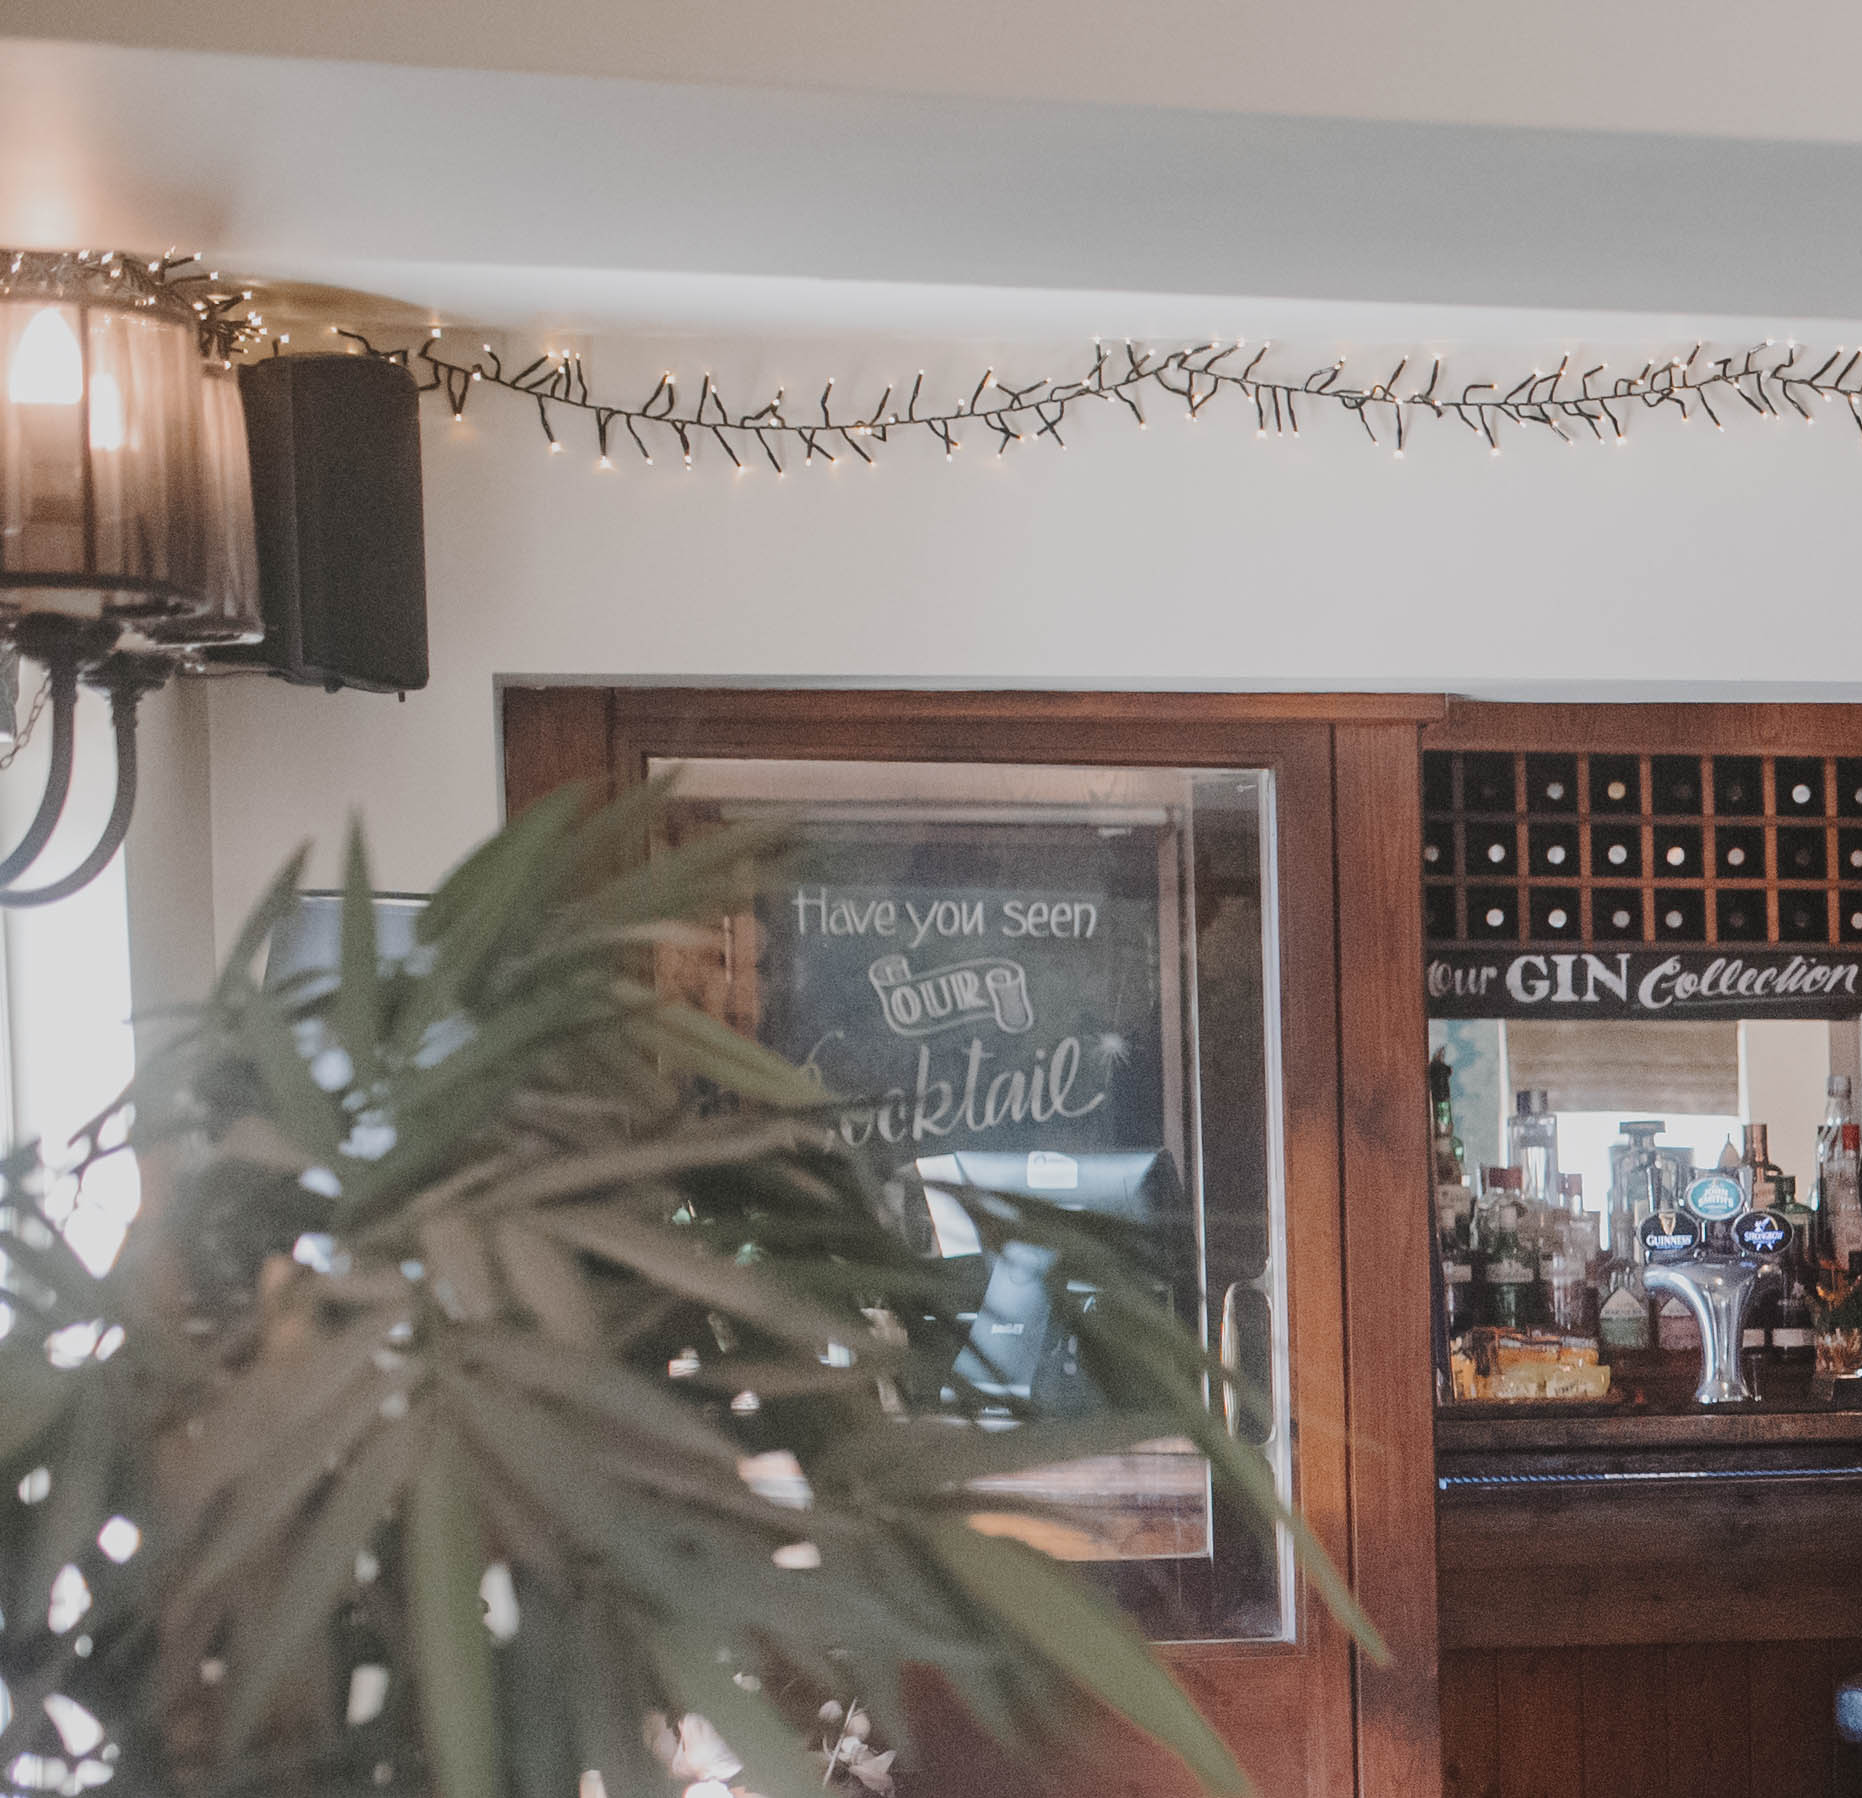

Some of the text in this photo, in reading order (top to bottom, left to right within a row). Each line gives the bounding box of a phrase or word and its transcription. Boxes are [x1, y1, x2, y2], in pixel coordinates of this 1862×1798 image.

[792, 887, 1098, 949] Have you seen
[890, 969, 991, 1025] OUR
[1504, 953, 1632, 1004] GIN
[1637, 955, 1860, 1010] Collection
[808, 1032, 1105, 1146] ocktail
[1645, 1234, 1693, 1246] GUINNESS
